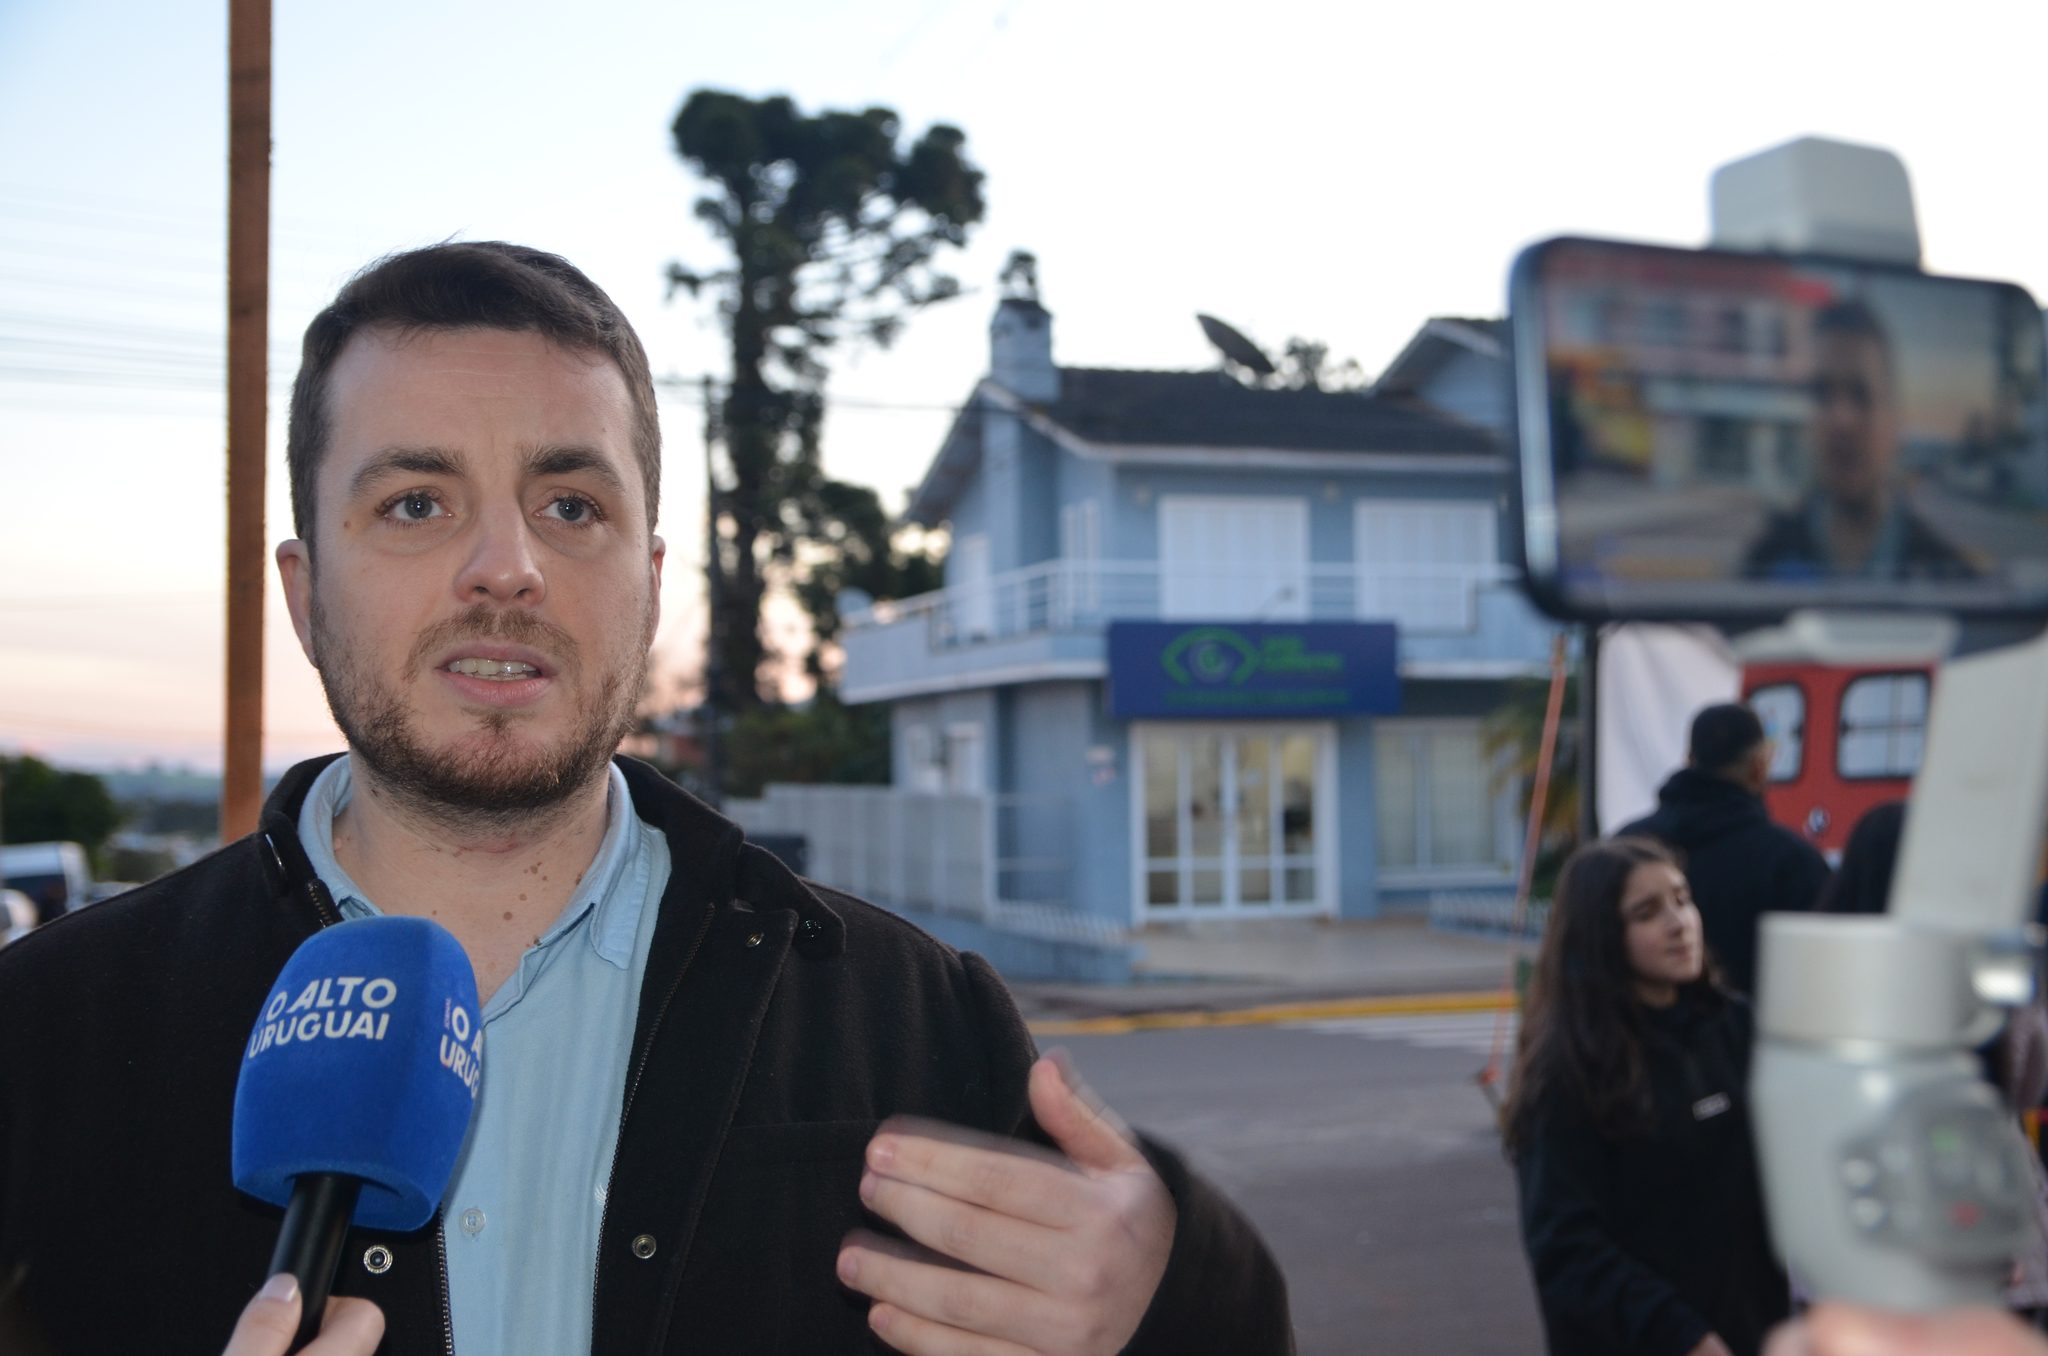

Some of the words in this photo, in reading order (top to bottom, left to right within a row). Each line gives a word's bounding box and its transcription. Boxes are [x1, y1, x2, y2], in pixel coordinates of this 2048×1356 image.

[266, 990, 288, 1022] O
[286, 976, 397, 1013] ALTO
[248, 1009, 390, 1059] URUGUAI
[451, 1006, 470, 1041] O
